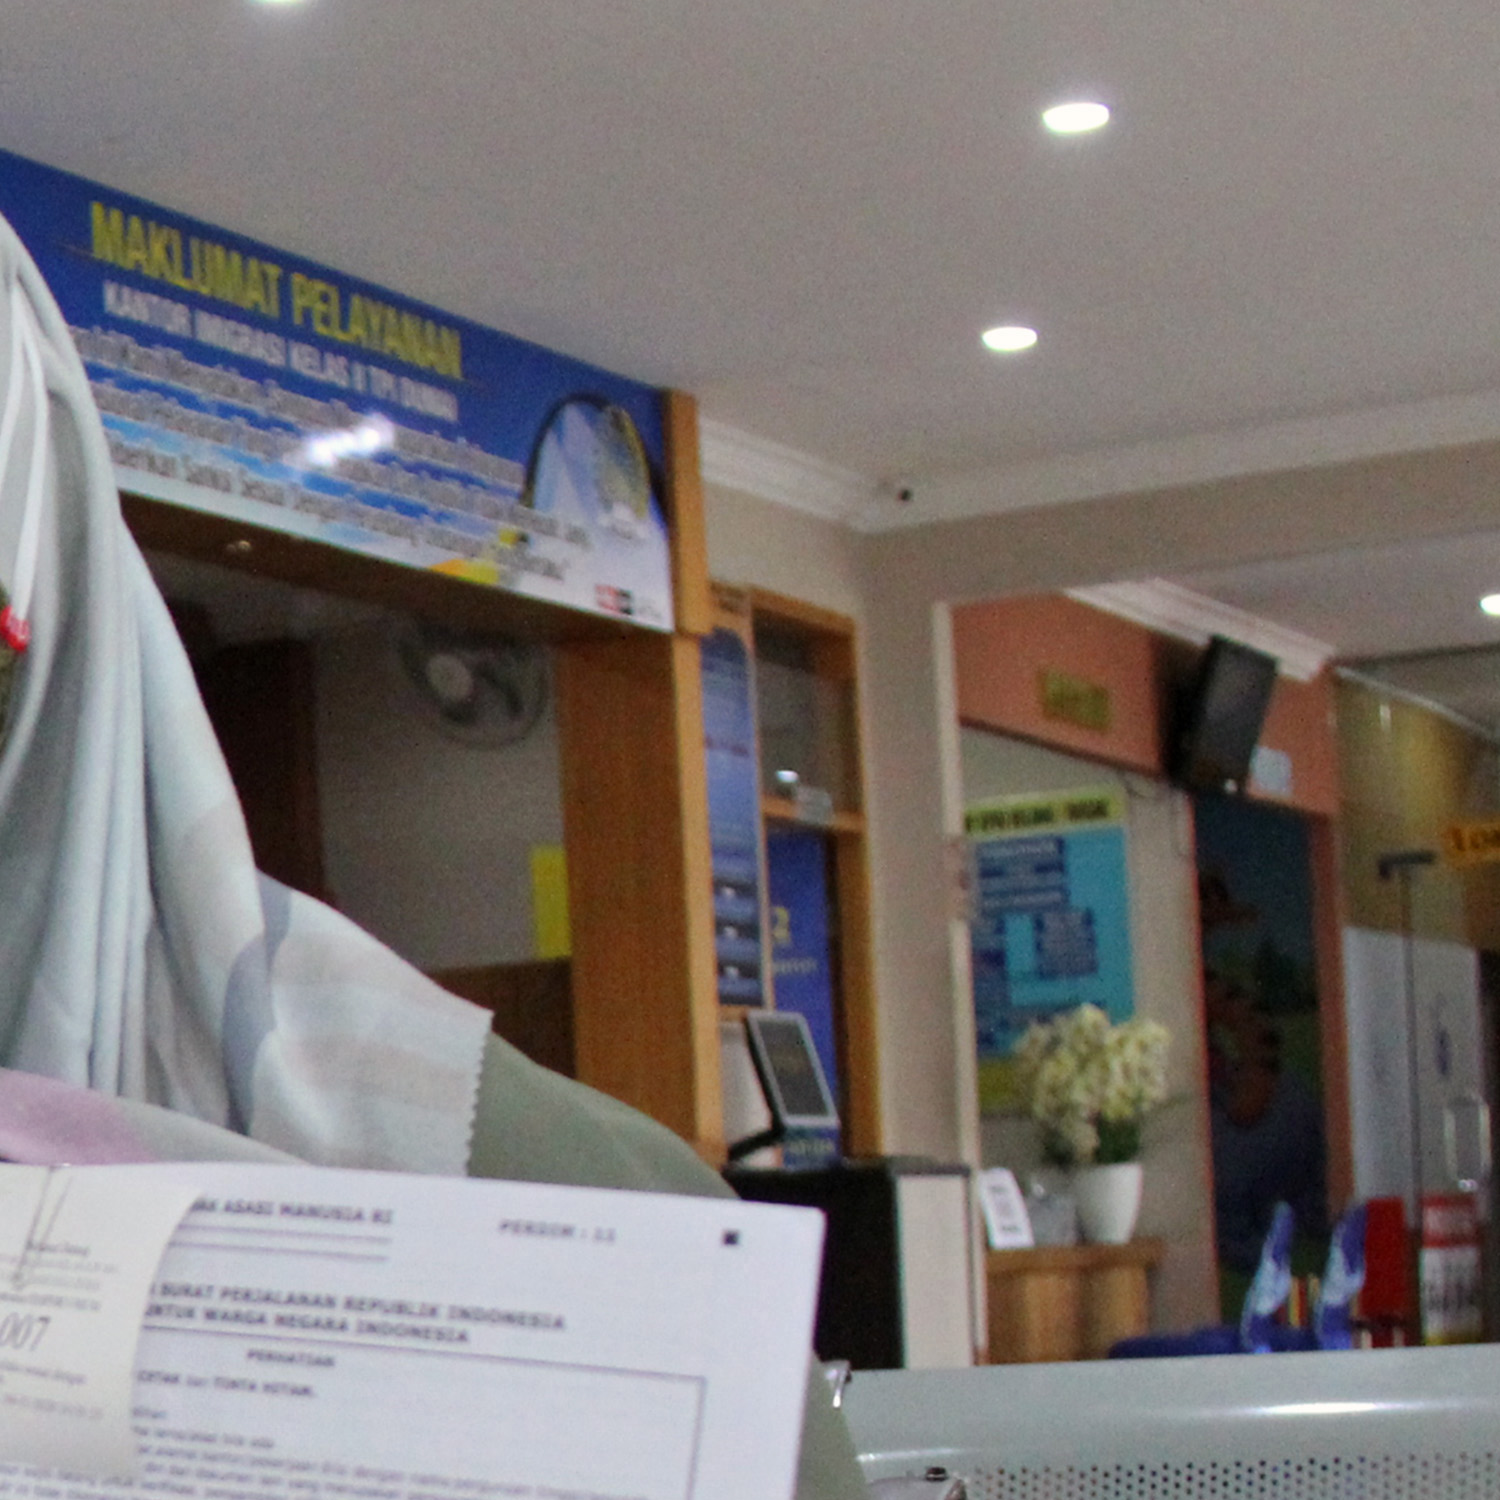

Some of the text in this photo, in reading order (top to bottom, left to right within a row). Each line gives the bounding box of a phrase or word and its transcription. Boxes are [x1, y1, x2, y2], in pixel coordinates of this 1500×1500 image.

[91, 201, 463, 381] MAKLUMAT PELAYANAN
[160, 1282, 567, 1331] SURAT PERJALANAN REPUBLIK INDONESIA
[204, 1307, 267, 1326] WARGA
[274, 1312, 349, 1333] NEGARA
[355, 1319, 470, 1344] INDONESIA
